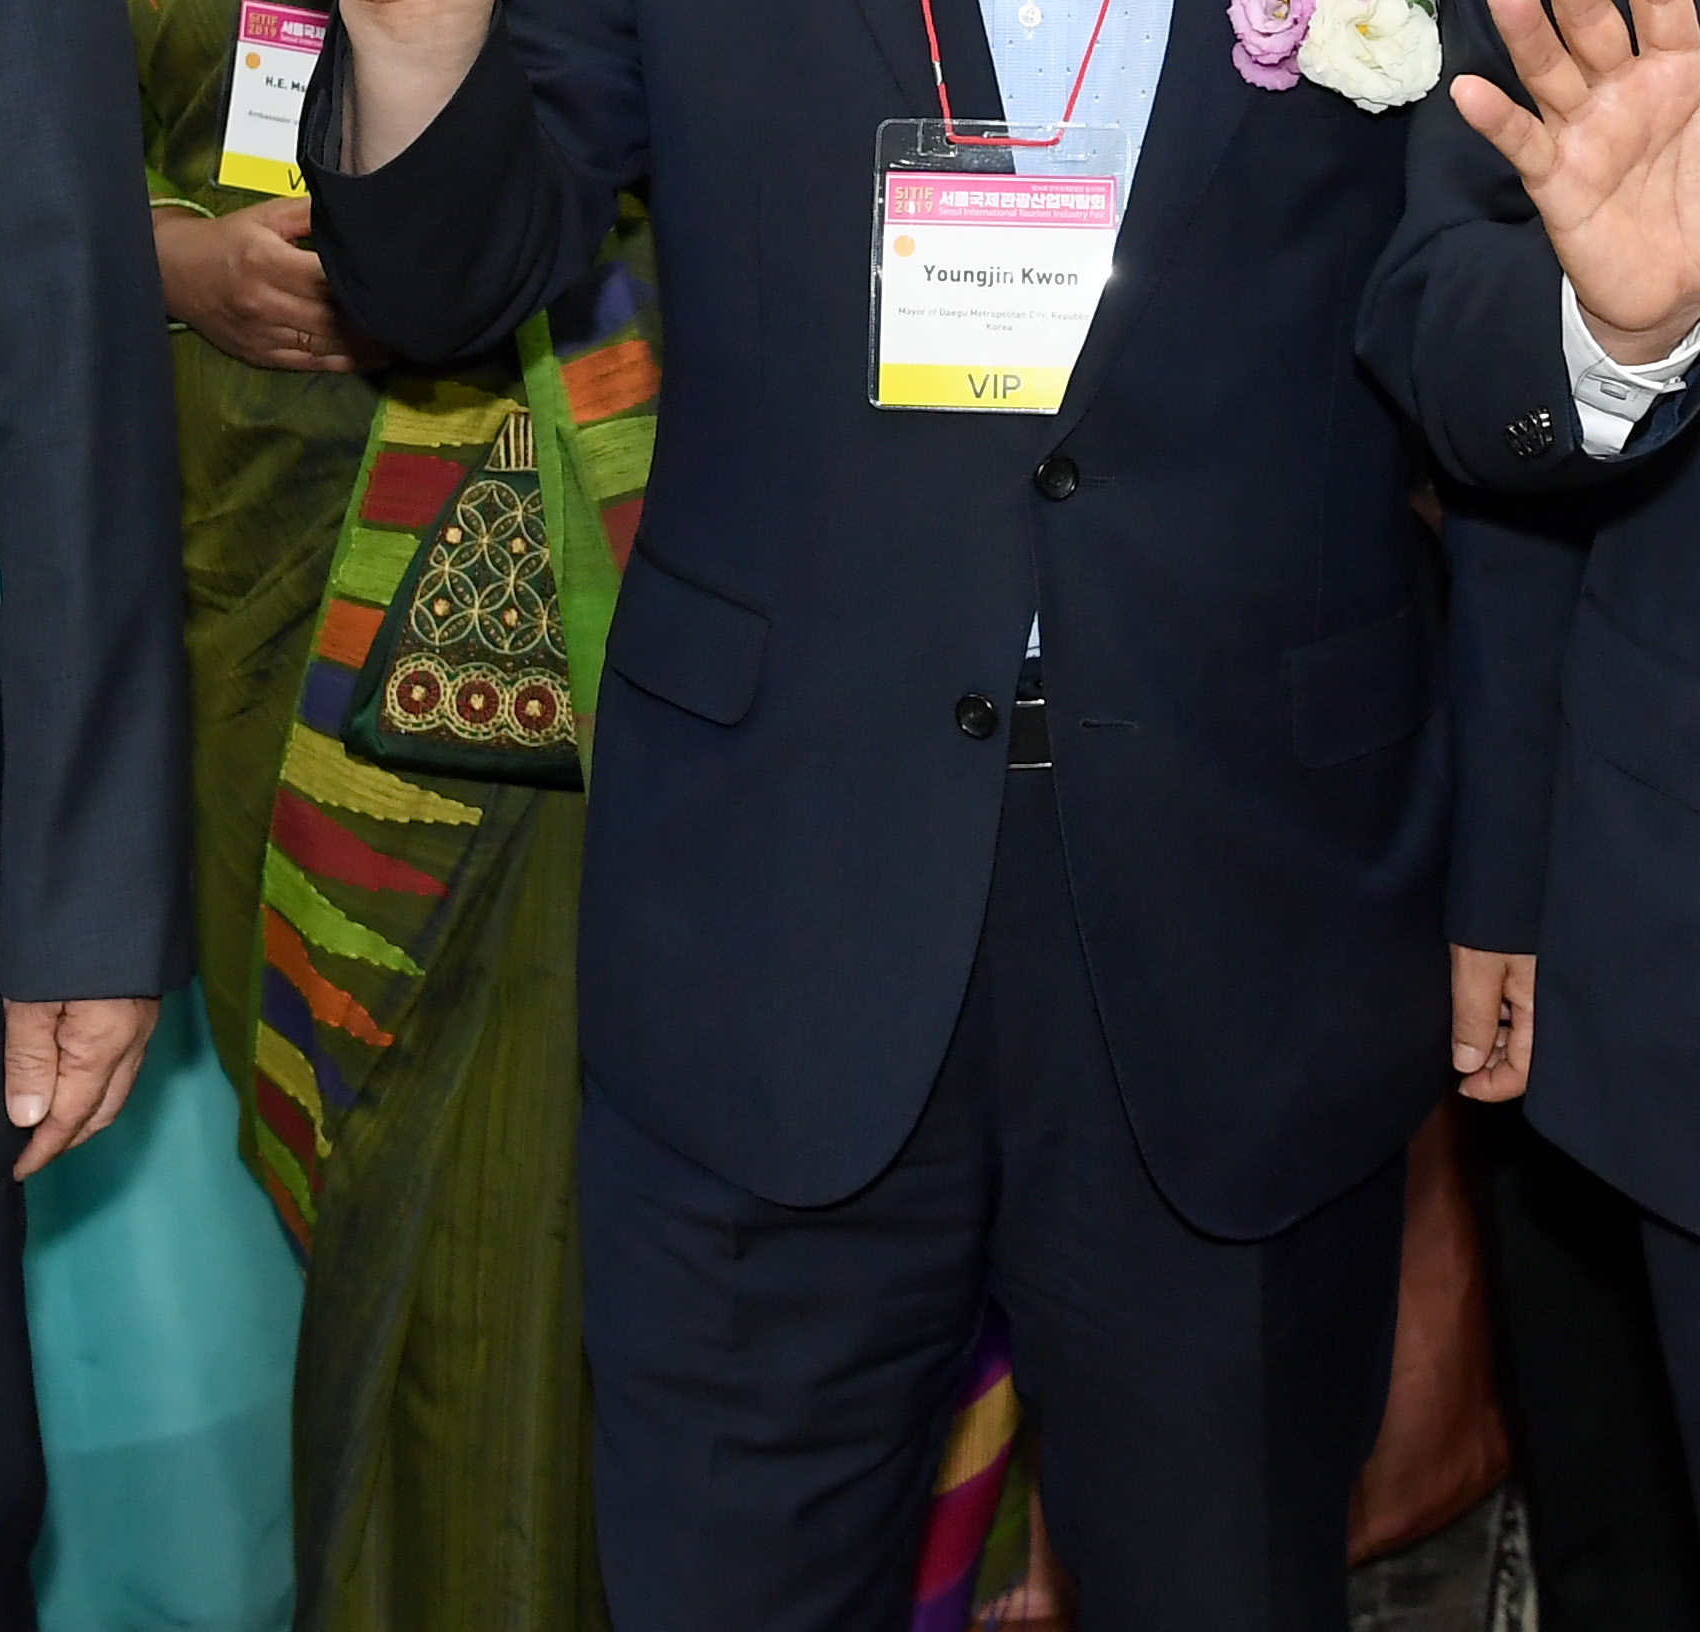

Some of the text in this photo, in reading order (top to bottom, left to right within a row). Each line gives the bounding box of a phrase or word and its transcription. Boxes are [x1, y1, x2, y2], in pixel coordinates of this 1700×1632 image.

[249, 13, 278, 25] SITIF
[249, 24, 278, 37] 2019
[265, 76, 287, 89] H.E.
[895, 187, 934, 200] SITIF
[939, 191, 1106, 210] 서울국제관광산업박람회
[939, 207, 1105, 220] Seoul International Tourism Industry Fair
[923, 265, 1079, 288] Youngjin Kwon
[898, 307, 925, 317] Mayor
[928, 308, 937, 316] of
[939, 309, 967, 319] Daegu
[970, 310, 1027, 320] Metropolitan
[986, 323, 1013, 332] Korea
[967, 373, 1022, 400] VIP
